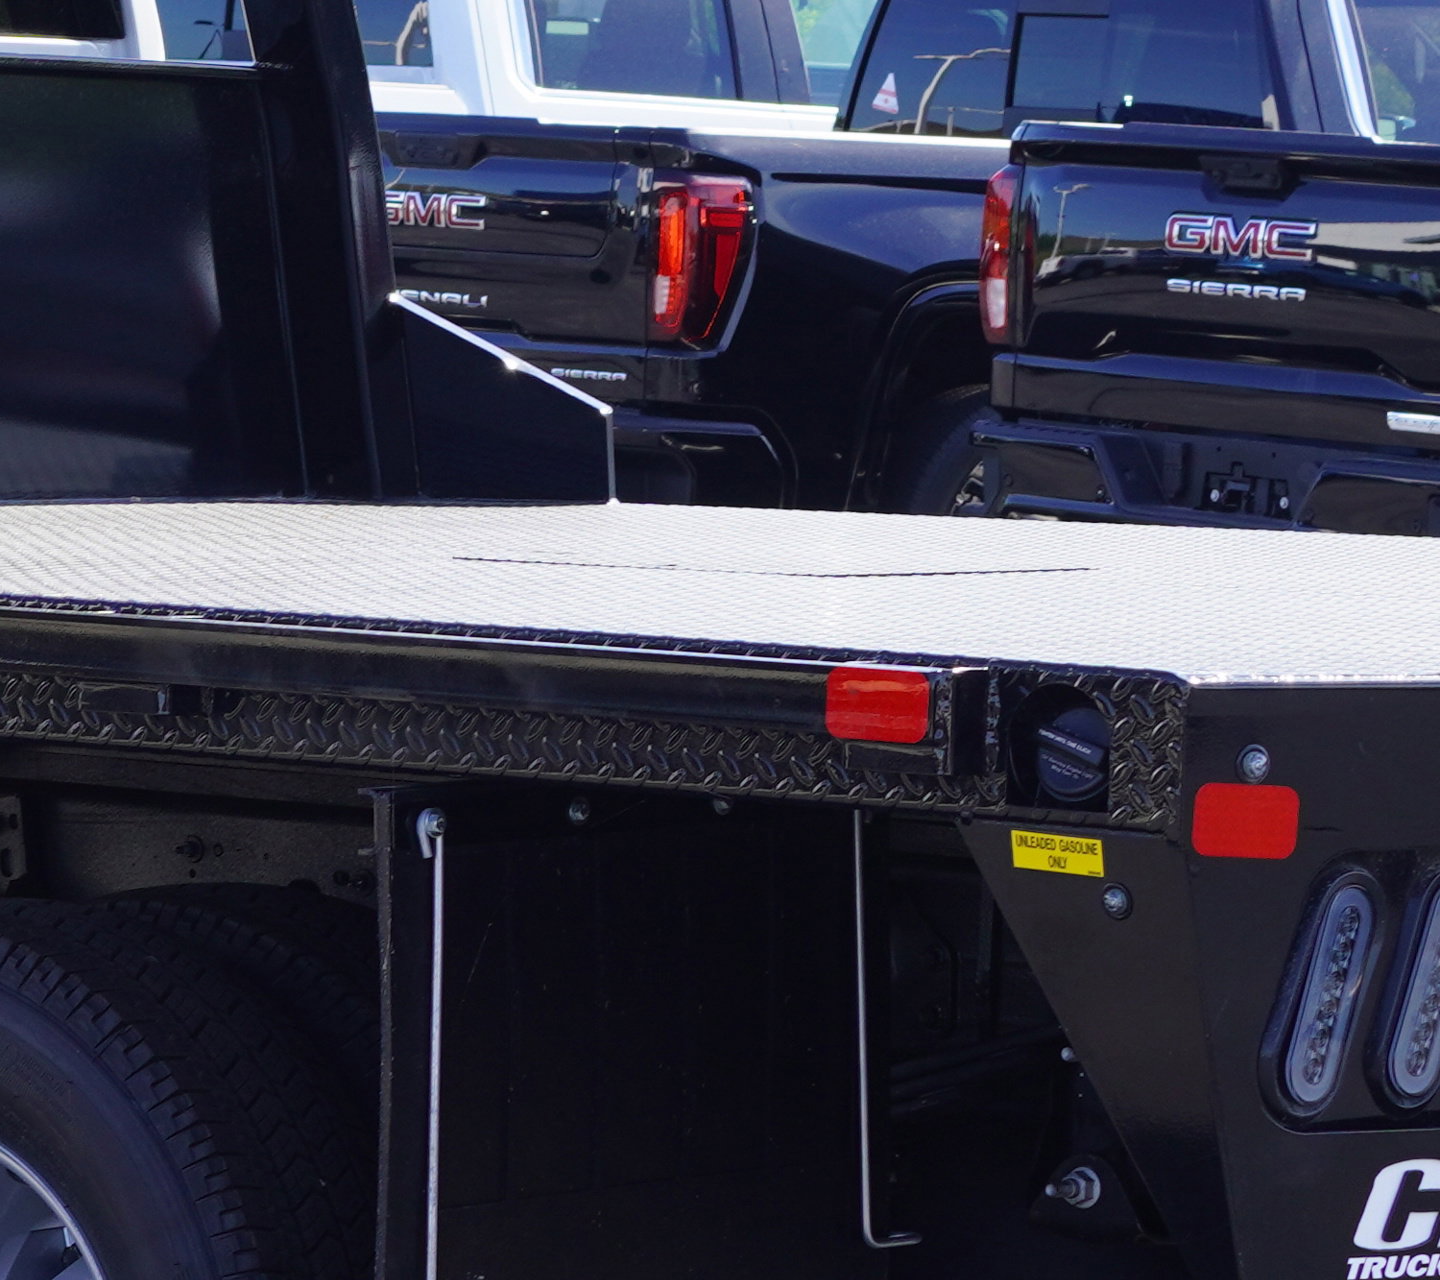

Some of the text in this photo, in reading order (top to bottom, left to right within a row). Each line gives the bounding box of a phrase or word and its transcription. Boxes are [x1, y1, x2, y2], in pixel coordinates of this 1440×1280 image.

[1165, 212, 1318, 261] GMC
[395, 289, 488, 307] ENALI
[1166, 278, 1307, 302] SIERRA
[551, 367, 627, 381] SIERRA
[1015, 834, 1099, 856] UNLEADED GASOLINE
[1048, 855, 1067, 869] ONLY
